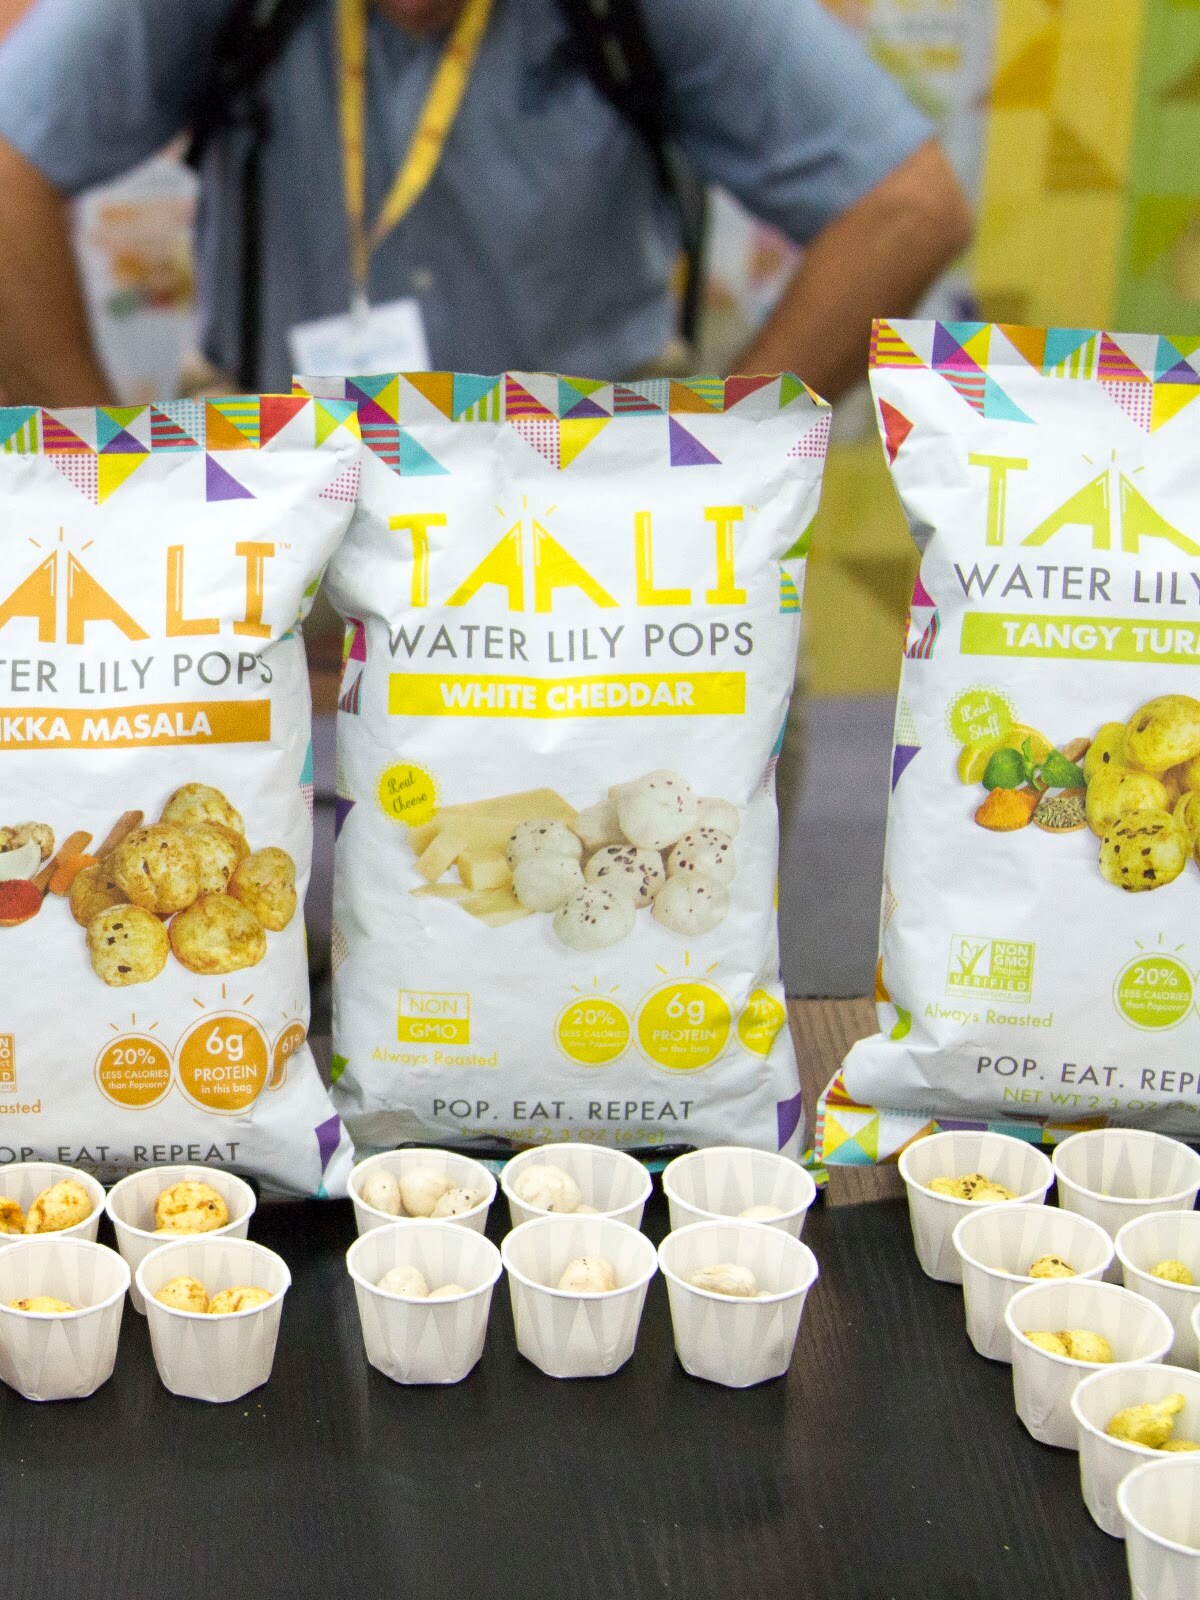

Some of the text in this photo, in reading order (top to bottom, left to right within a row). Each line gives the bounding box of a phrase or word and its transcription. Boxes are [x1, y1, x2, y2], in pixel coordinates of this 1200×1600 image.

[953, 563, 1112, 601] WATER
[388, 622, 753, 662] WATER LILY POPS
[1002, 621, 1200, 655] TANGY TUR
[79, 657, 154, 694] LILY
[173, 651, 273, 686] POPS
[440, 682, 695, 710] WHITE CHEDDAR
[961, 697, 992, 722] Real
[81, 712, 212, 741] MASALA
[387, 770, 417, 795] Real
[392, 792, 428, 813] Cheese
[995, 943, 1029, 955] NON
[994, 954, 1029, 967] GMO
[953, 975, 1027, 992] VERIFIED
[1133, 966, 1179, 986] 20%
[409, 999, 458, 1014] NON
[573, 1009, 615, 1025] 20%
[666, 992, 705, 1026] 6g
[924, 1002, 1054, 1028] Always Roasted
[409, 1023, 458, 1039] GMO
[652, 1029, 717, 1042] PROTEIN
[205, 1026, 244, 1062] 6g
[112, 1048, 156, 1065] 20%
[372, 1045, 498, 1067] Always Roasted
[102, 1069, 169, 1079] LESS CALORIES
[194, 1065, 257, 1081] PROTEIN
[976, 1056, 1200, 1094] POP. EAT. REP
[108, 1081, 126, 1089] than
[201, 1082, 252, 1094] in this bag
[1003, 1087, 1044, 1103] NET
[1050, 1091, 1081, 1107] WT
[433, 1099, 694, 1121] POP. EAT. REPEAT
[57, 1146, 119, 1163] EAT.
[133, 1142, 241, 1163] REPEAT
